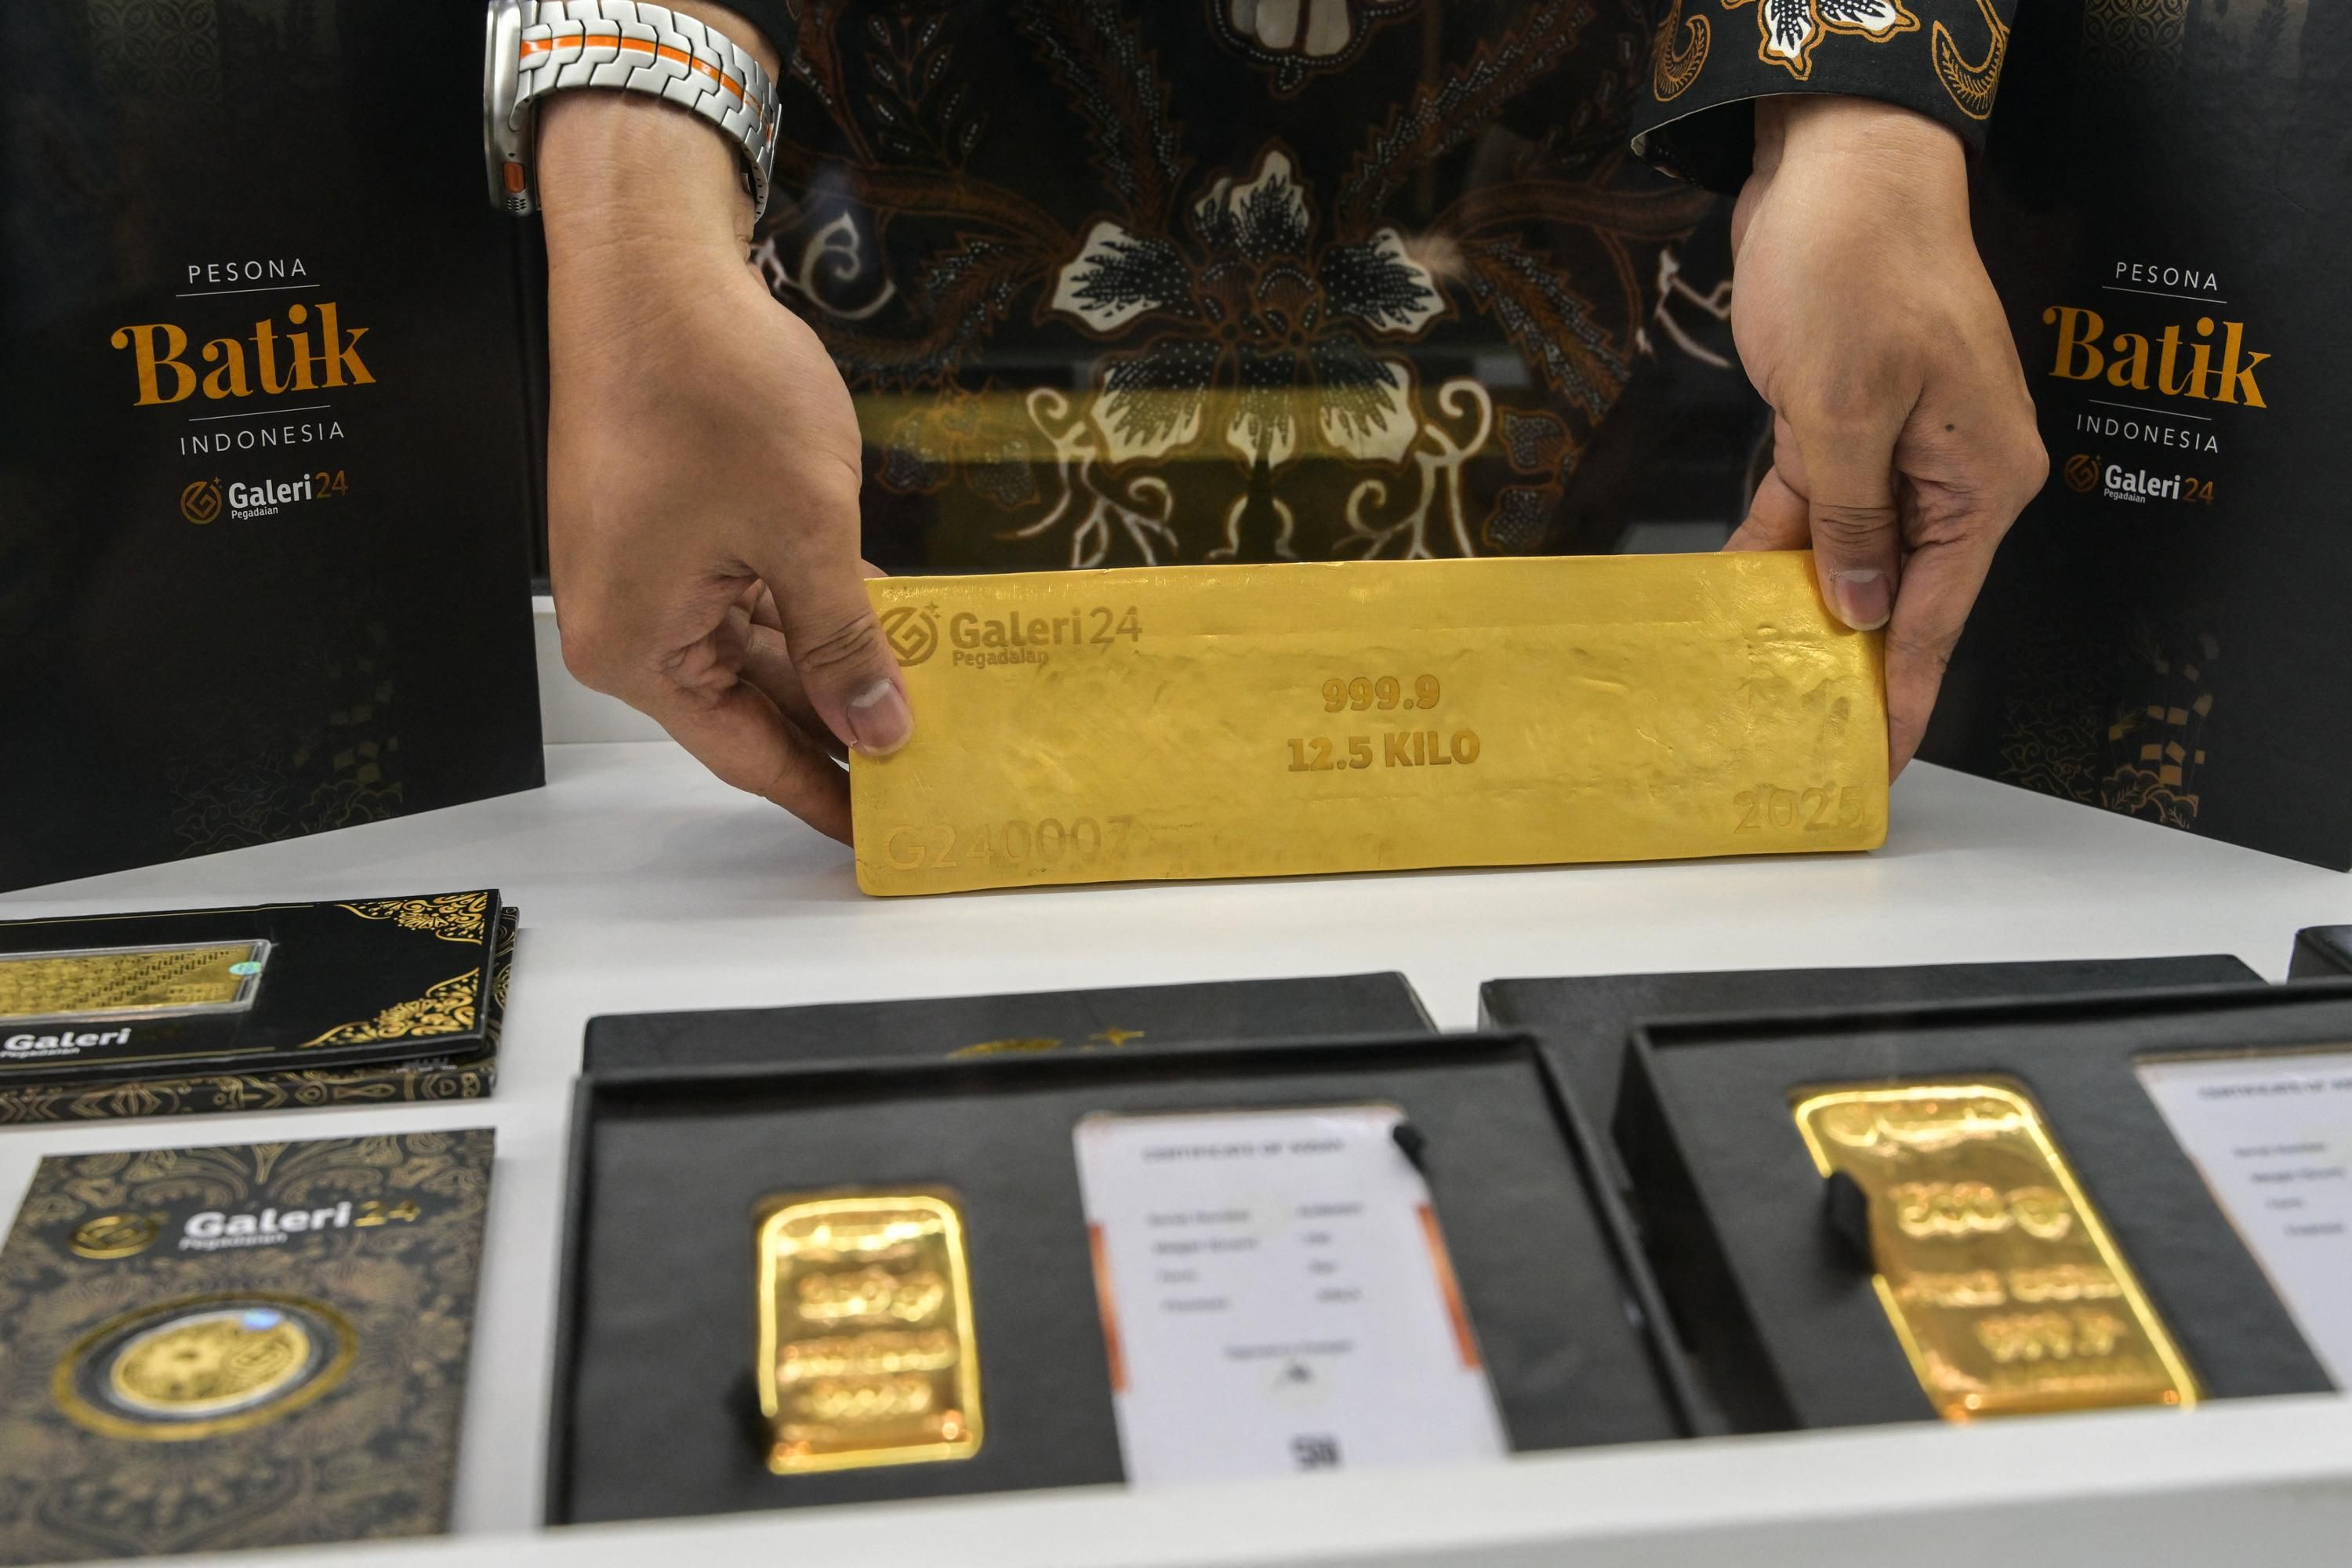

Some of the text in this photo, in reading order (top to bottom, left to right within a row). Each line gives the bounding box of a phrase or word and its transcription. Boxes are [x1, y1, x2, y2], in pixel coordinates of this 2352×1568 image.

[187, 257, 307, 285] PESONA
[2115, 261, 2218, 292] PESONA
[111, 301, 377, 407] Batik
[2042, 305, 2272, 408] Batik
[180, 420, 345, 456] INDONESIA
[2076, 413, 2219, 454] INDONESIA
[228, 473, 312, 509] Galeri
[2103, 488, 2147, 504] Pegadaian
[2104, 464, 2181, 500] Galeri
[230, 506, 279, 521] Pegadaian
[949, 607, 1083, 649] Galeri
[952, 648, 1049, 670] Pegadaian
[1322, 673, 1441, 713] 999.9
[1287, 728, 1481, 772] 12.5 KILO
[1732, 786, 1866, 835] 2025
[4, 1027, 132, 1051] Galeri
[183, 1200, 353, 1238] Galeri
